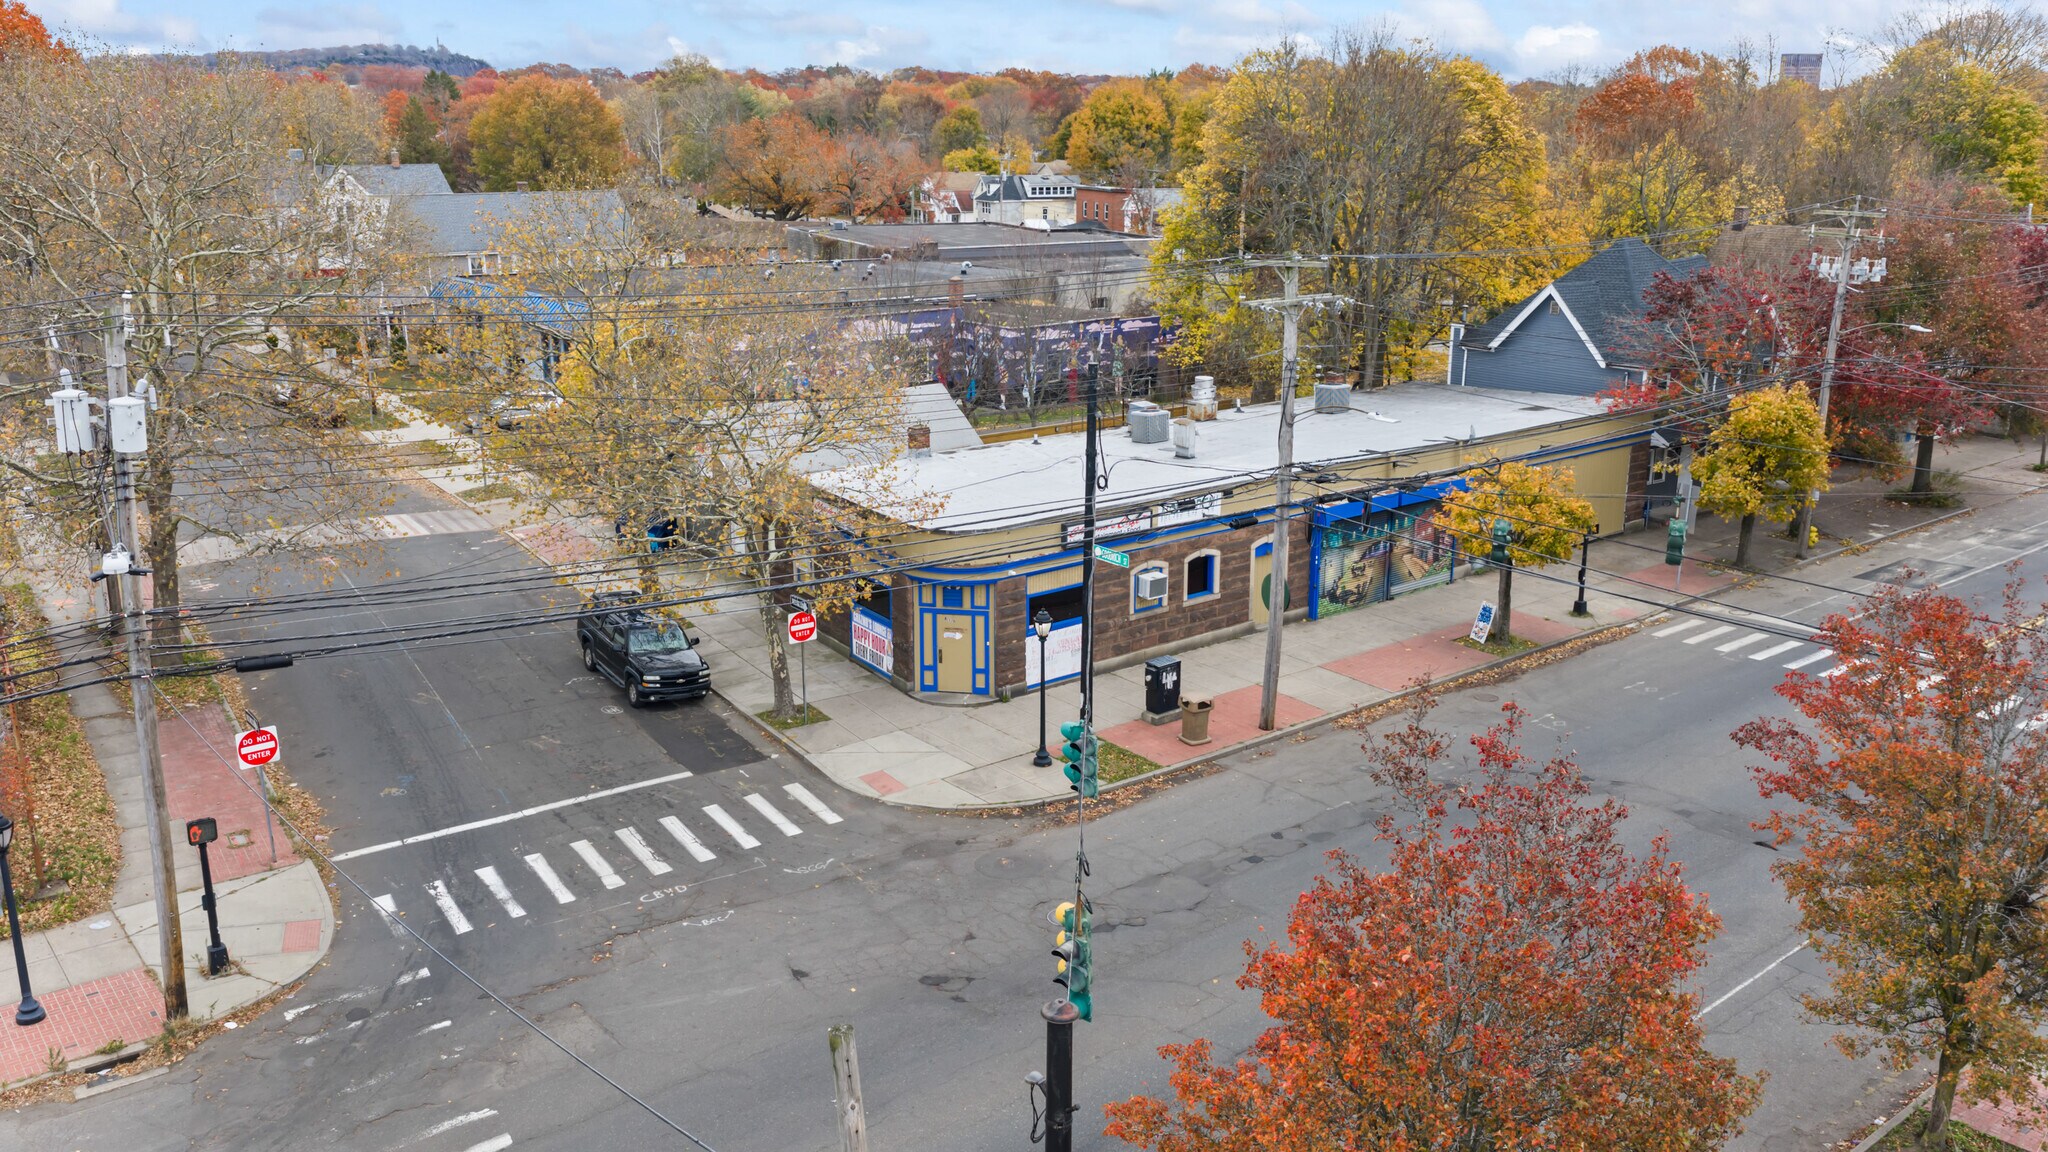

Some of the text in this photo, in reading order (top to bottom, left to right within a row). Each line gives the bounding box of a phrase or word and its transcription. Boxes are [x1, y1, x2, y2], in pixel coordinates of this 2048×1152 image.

[853, 623, 886, 656] HAPPY HOUR
[856, 641, 884, 669] EVERY FRIDAY
[243, 734, 271, 746] DO NOT
[247, 750, 271, 760] ENTER
